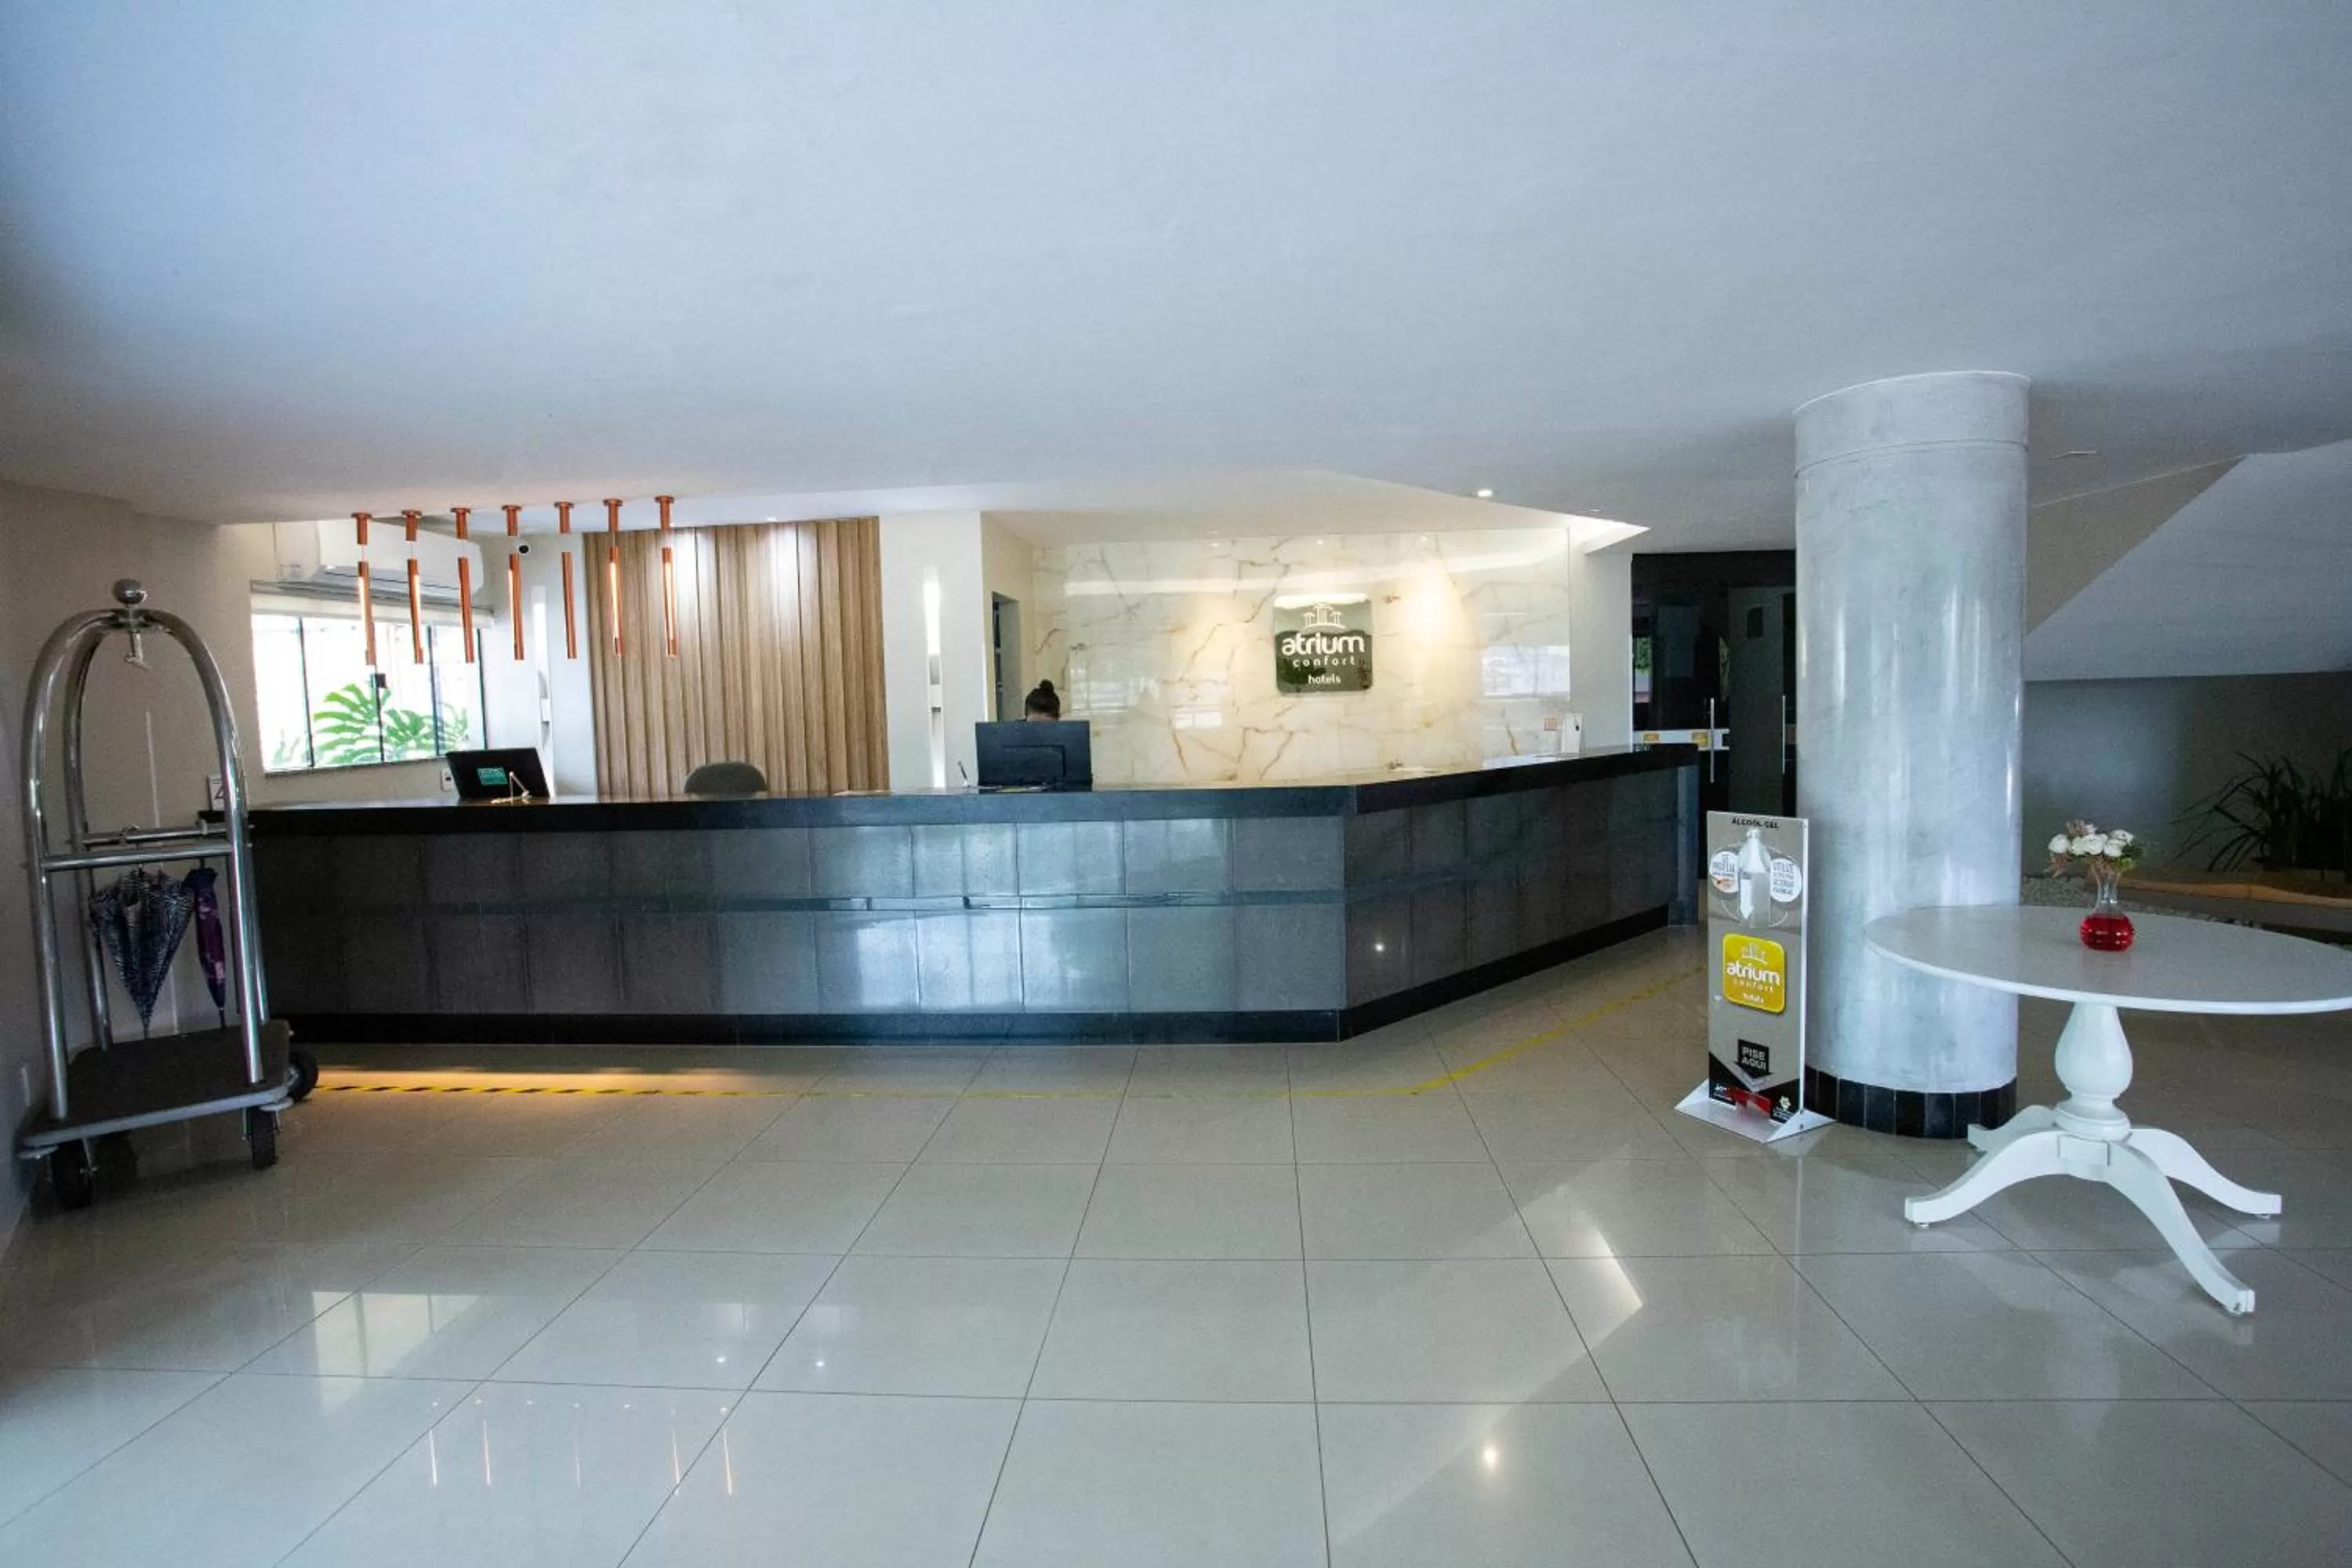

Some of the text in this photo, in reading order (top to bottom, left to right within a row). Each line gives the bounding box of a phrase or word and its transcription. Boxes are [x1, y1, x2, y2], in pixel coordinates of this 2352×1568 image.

[1281, 633, 1365, 655] atrium
[1293, 655, 1356, 667] confort
[1308, 673, 1341, 684] hotels
[1726, 960, 1780, 986] atrium
[1742, 1047, 1765, 1061] PISE
